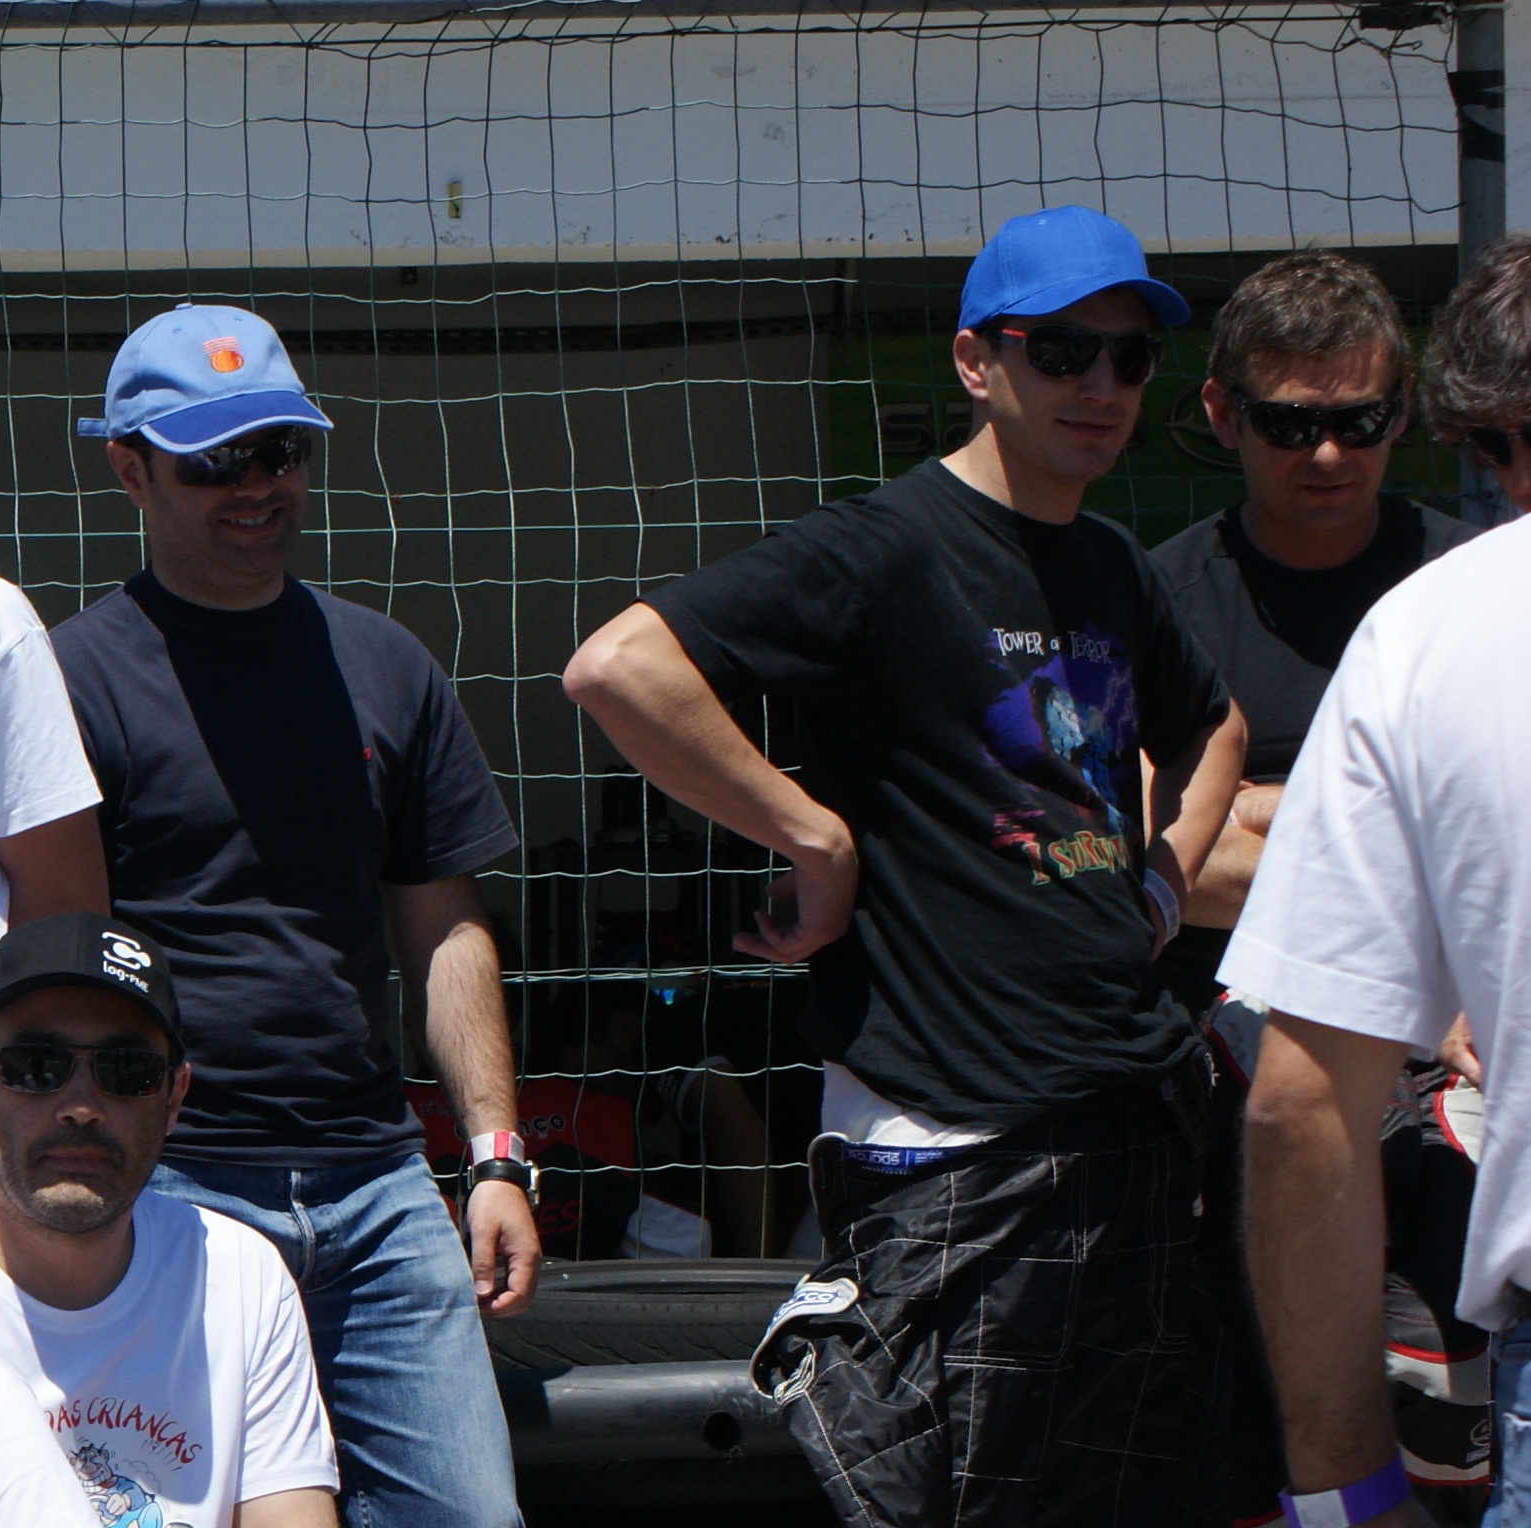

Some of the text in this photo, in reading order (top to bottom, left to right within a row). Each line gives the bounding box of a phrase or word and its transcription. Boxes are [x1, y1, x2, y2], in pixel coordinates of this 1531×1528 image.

[993, 628, 1044, 656] TOWER
[1067, 631, 1112, 664] TERROR
[87, 1397, 202, 1464] CRIANÇAS
